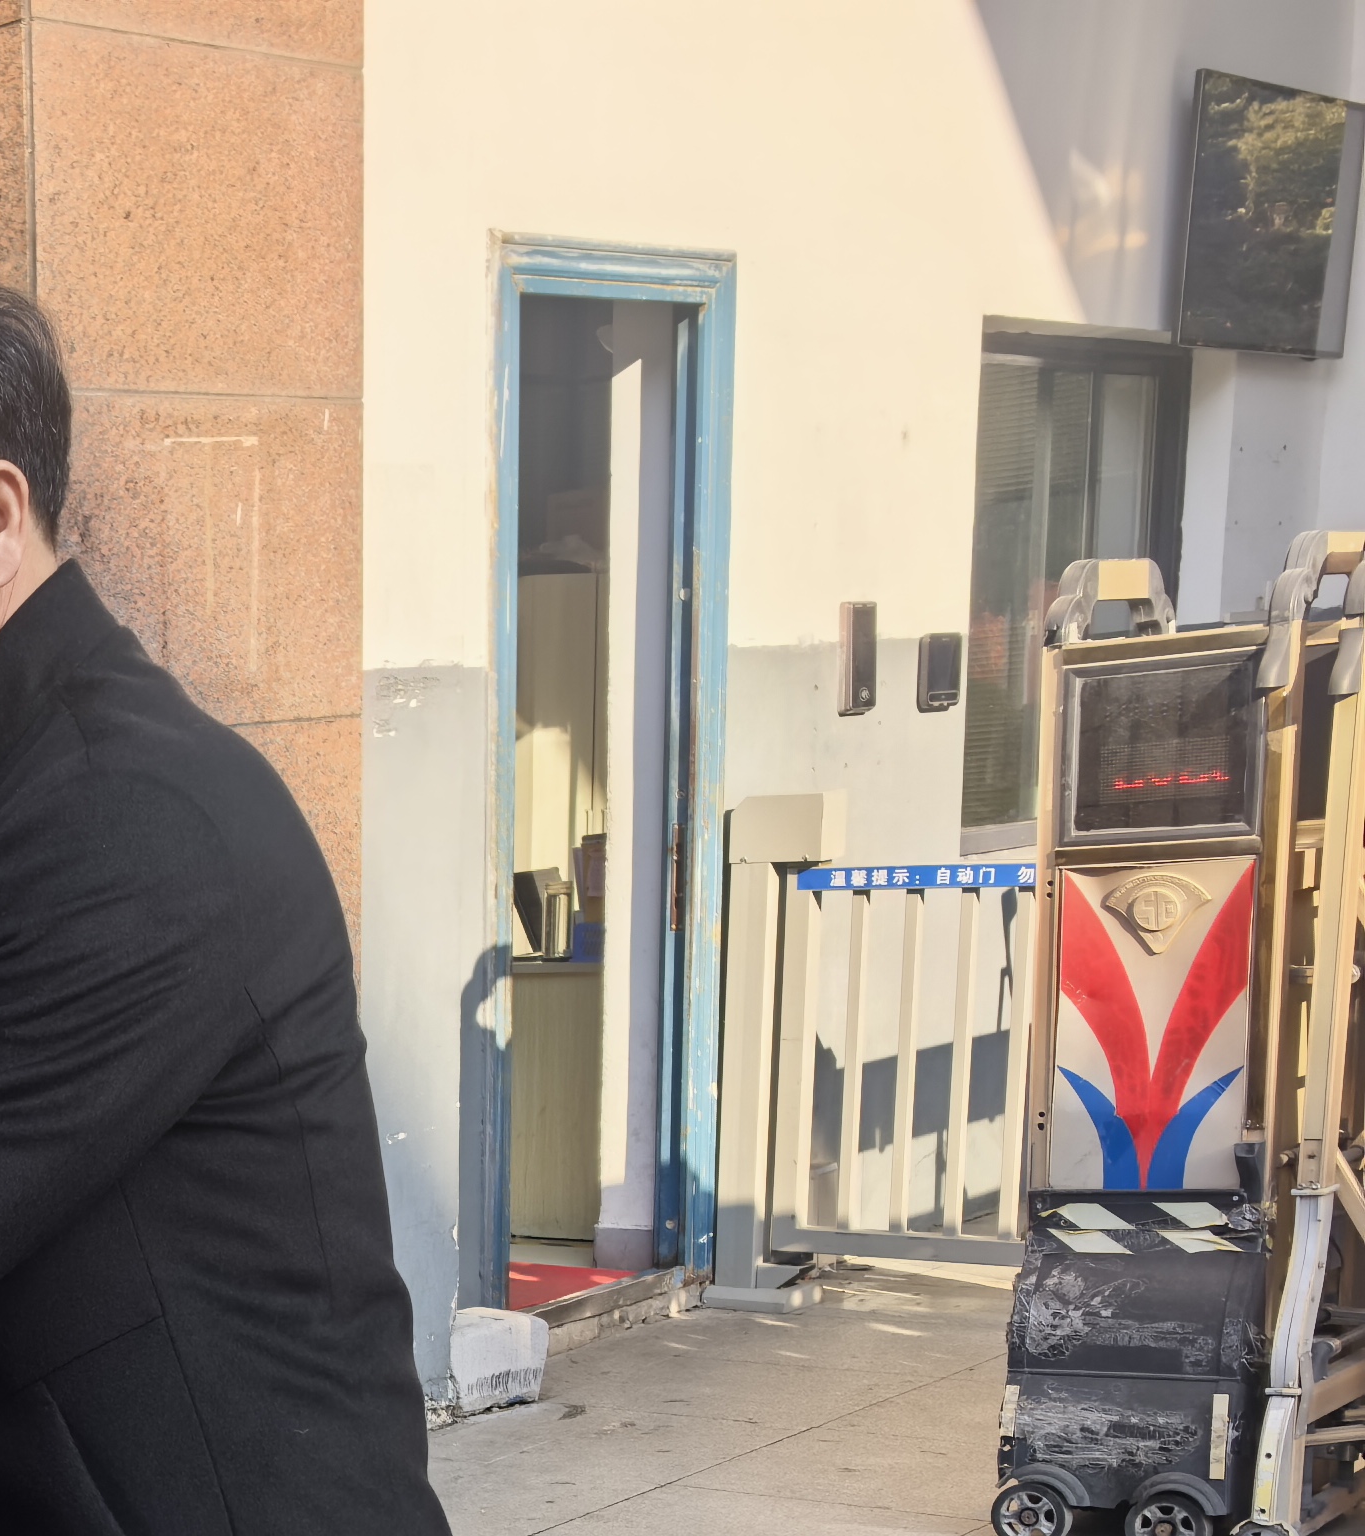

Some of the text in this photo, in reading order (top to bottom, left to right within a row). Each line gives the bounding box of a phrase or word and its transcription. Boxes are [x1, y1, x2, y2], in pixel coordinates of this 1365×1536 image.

[936, 866, 996, 885] 自动门
[1017, 866, 1035, 884] 勿
